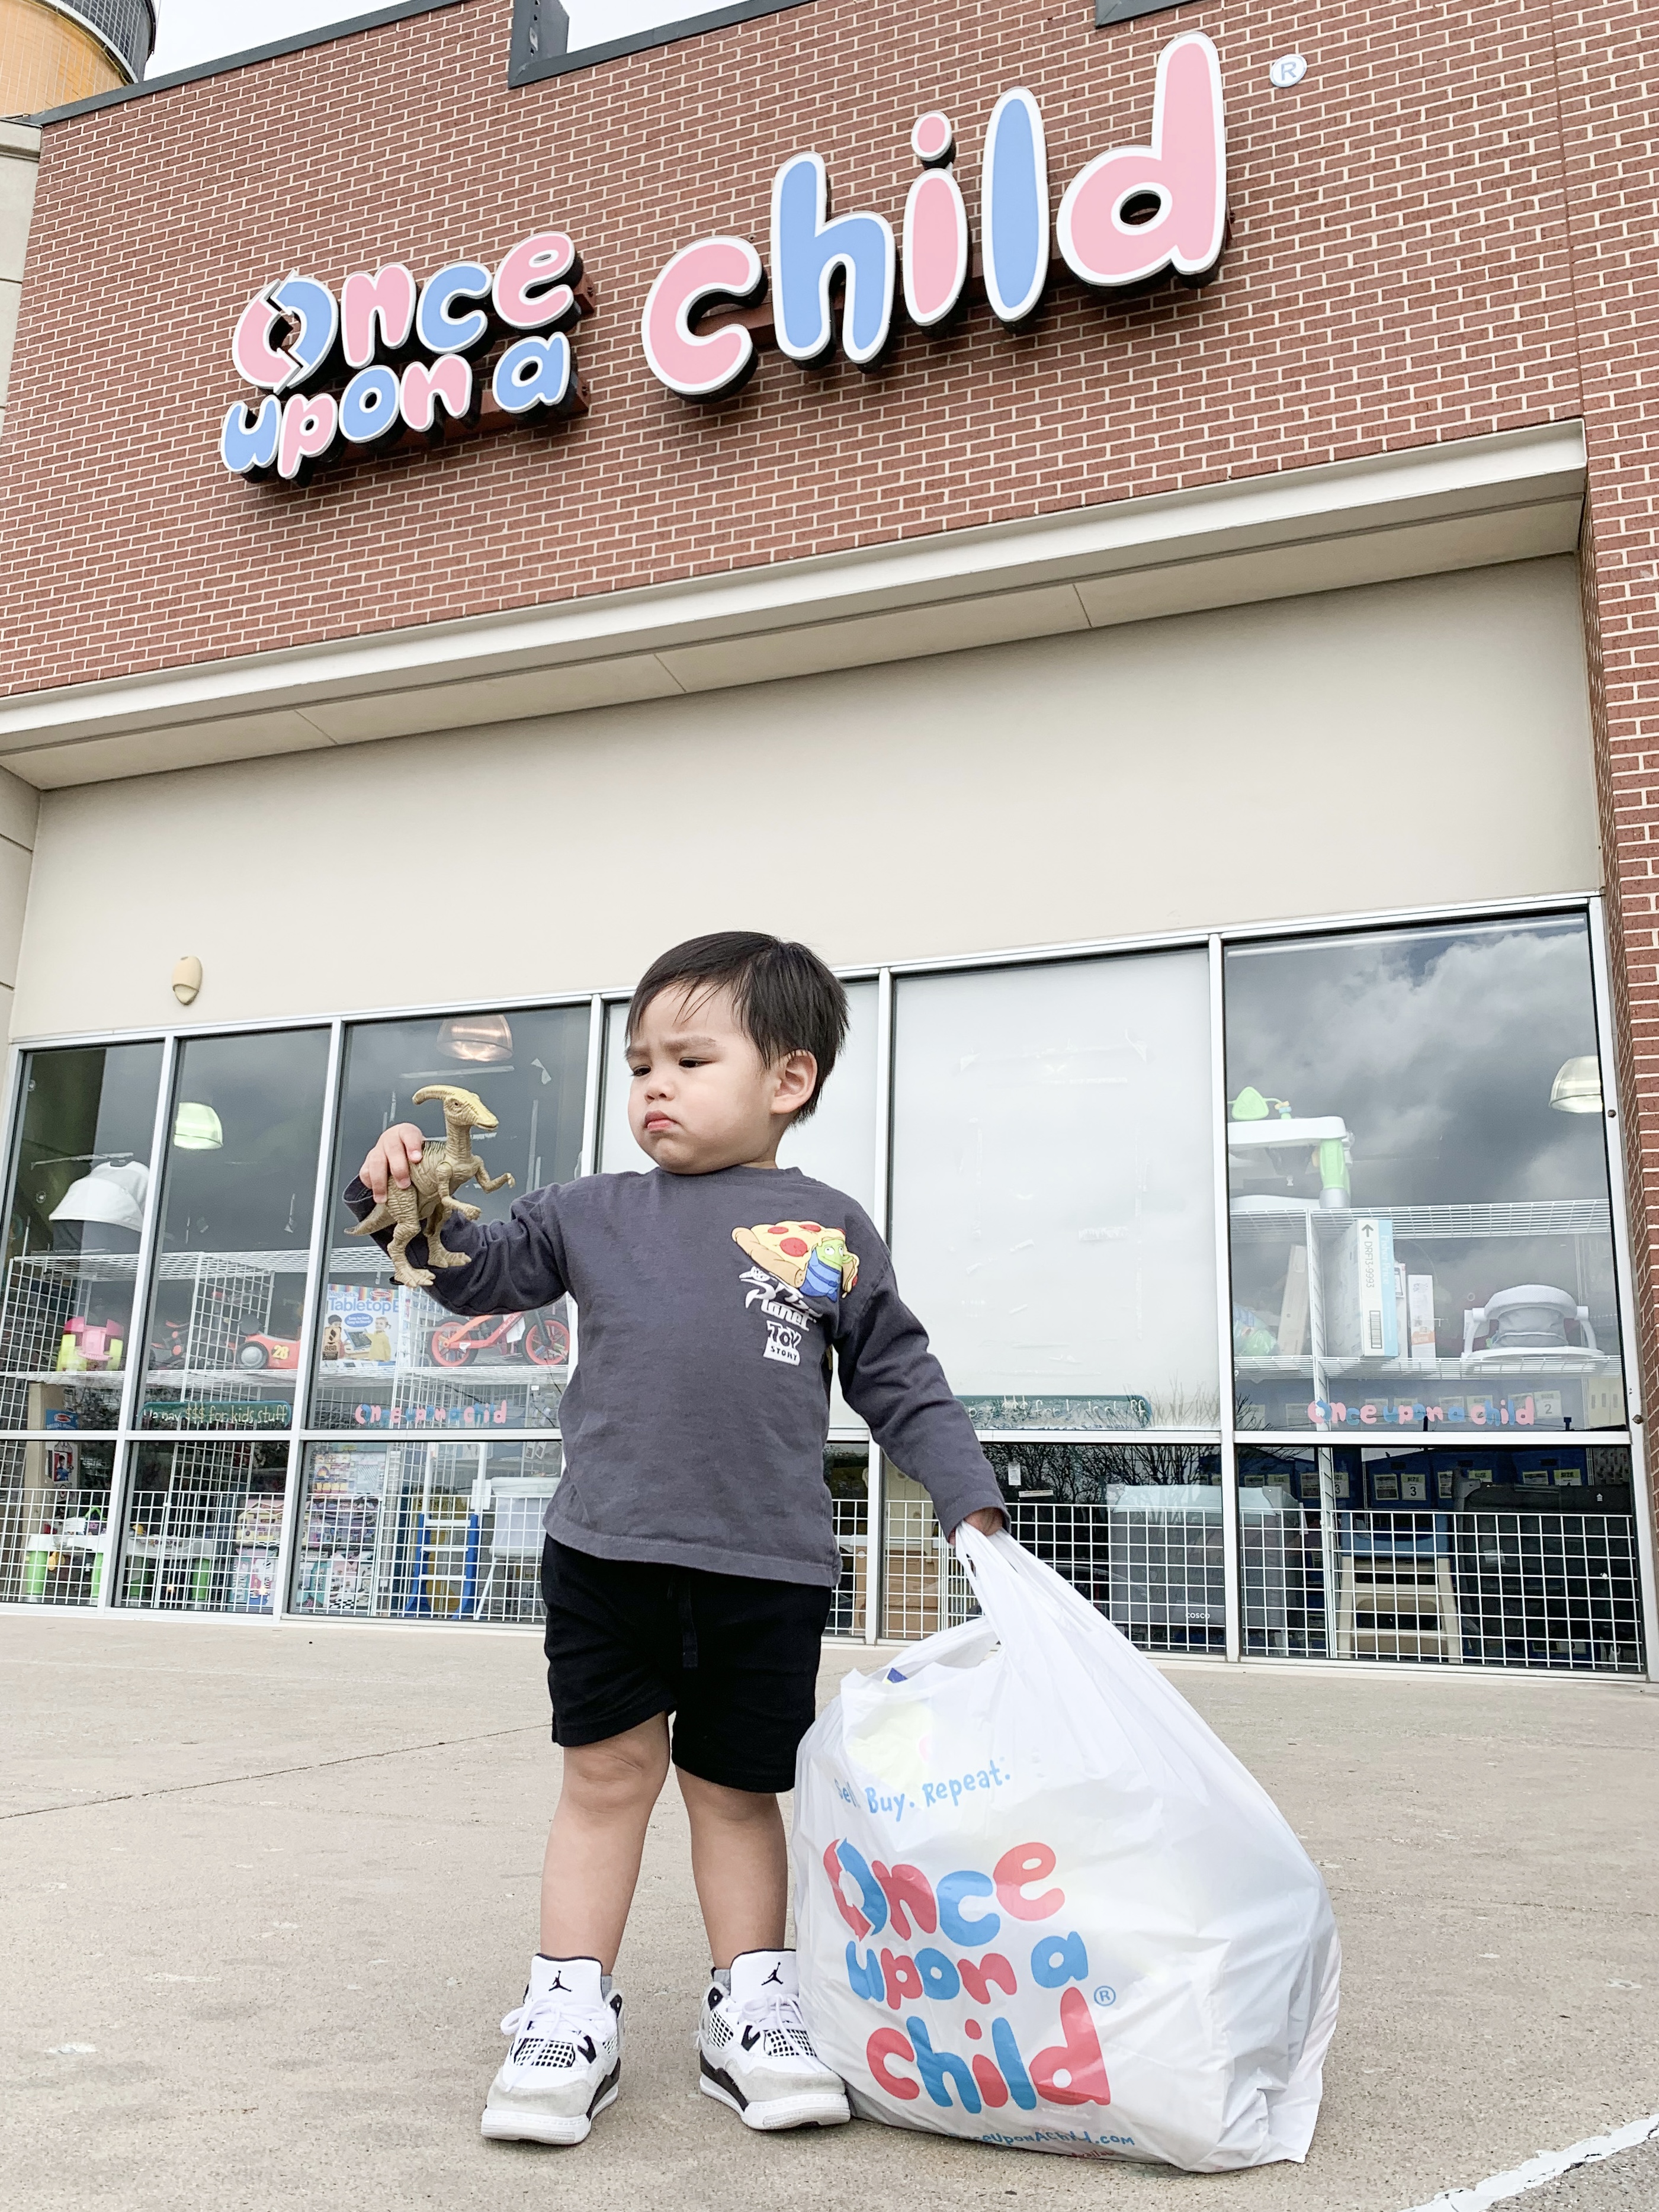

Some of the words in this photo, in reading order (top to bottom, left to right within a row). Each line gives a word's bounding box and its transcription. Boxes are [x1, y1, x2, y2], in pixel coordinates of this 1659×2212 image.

[641, 31, 1227, 396] child
[232, 231, 576, 394] Once
[220, 354, 473, 479] upon
[492, 331, 570, 413] a
[1364, 1241, 1375, 1288] DRF13-9993
[328, 1297, 391, 1315] Tabletop
[272, 1344, 290, 1360] 28
[768, 1322, 801, 1350] TOY
[771, 1345, 797, 1361] STORY
[231, 1404, 254, 1424] kids
[257, 1404, 288, 1424] stuff
[1308, 1399, 1377, 1424] Once
[1382, 1404, 1443, 1424] upon
[1448, 1407, 1465, 1421] a
[1471, 1396, 1534, 1426] child
[1544, 1404, 1552, 1414] 2
[1410, 1486, 1417, 1497] 3
[865, 1787, 914, 1822] Buy.
[923, 1759, 1010, 1807] Repeat.
[823, 1838, 1065, 1947] Once
[846, 1941, 1017, 2009] upon
[1031, 1931, 1089, 1989] a
[867, 1987, 1111, 2114] child
